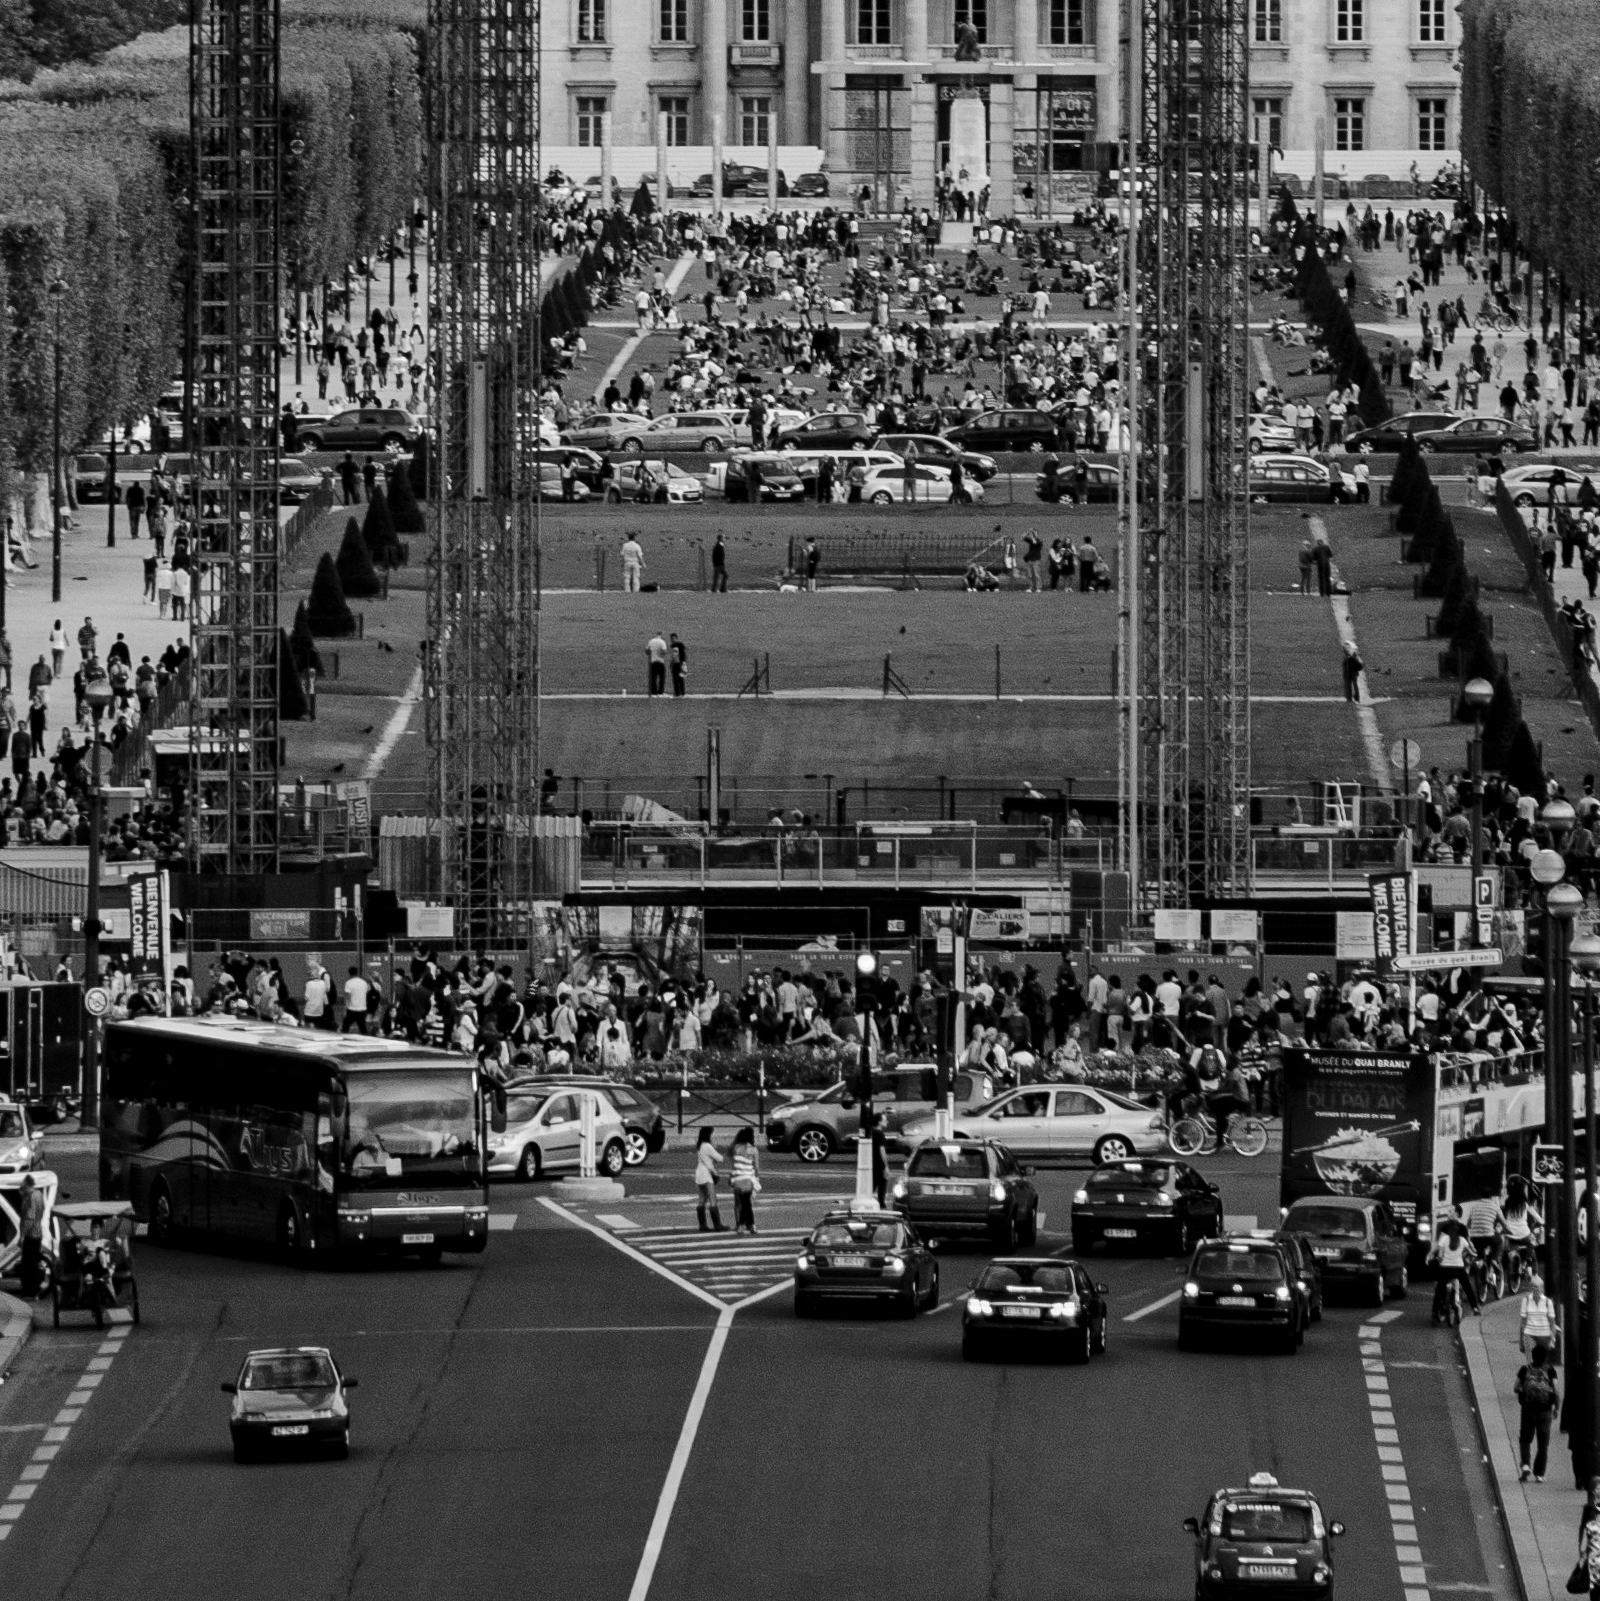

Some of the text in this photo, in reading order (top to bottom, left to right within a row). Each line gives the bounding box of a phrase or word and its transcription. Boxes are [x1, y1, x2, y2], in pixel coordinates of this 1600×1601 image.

[130, 882, 145, 957] WELCOME
[146, 877, 160, 960] BIENVENUE
[1373, 882, 1392, 957] WELCOME
[1391, 877, 1408, 956] BIENVENU
[1341, 1057, 1354, 1067] DU
[1354, 1057, 1376, 1068] QUAI
[1377, 1058, 1411, 1069] BRANLY
